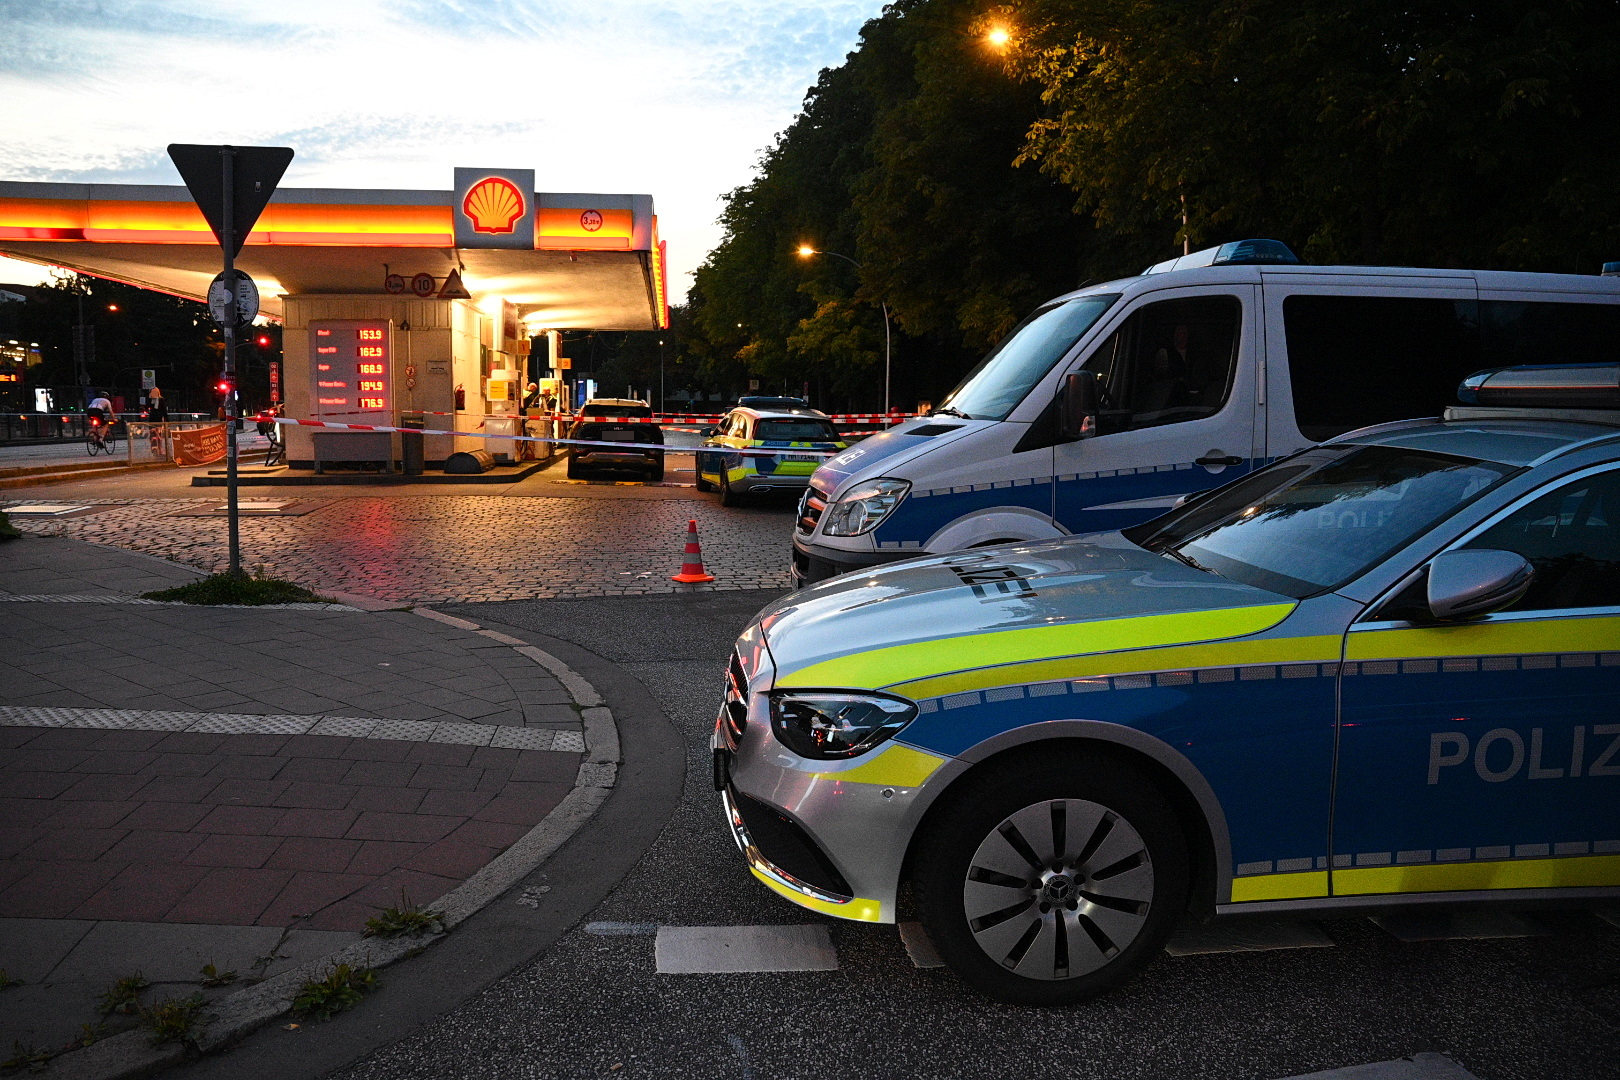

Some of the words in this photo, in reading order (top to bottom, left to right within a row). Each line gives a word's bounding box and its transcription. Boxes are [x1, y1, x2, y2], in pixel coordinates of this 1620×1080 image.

[418, 280, 429, 290] 10
[360, 330, 382, 340] 153.9
[360, 347, 382, 357] 162.9
[361, 381, 383, 391] 194.9
[361, 398, 383, 408] 176.9
[1428, 724, 1620, 784] POLIZ
